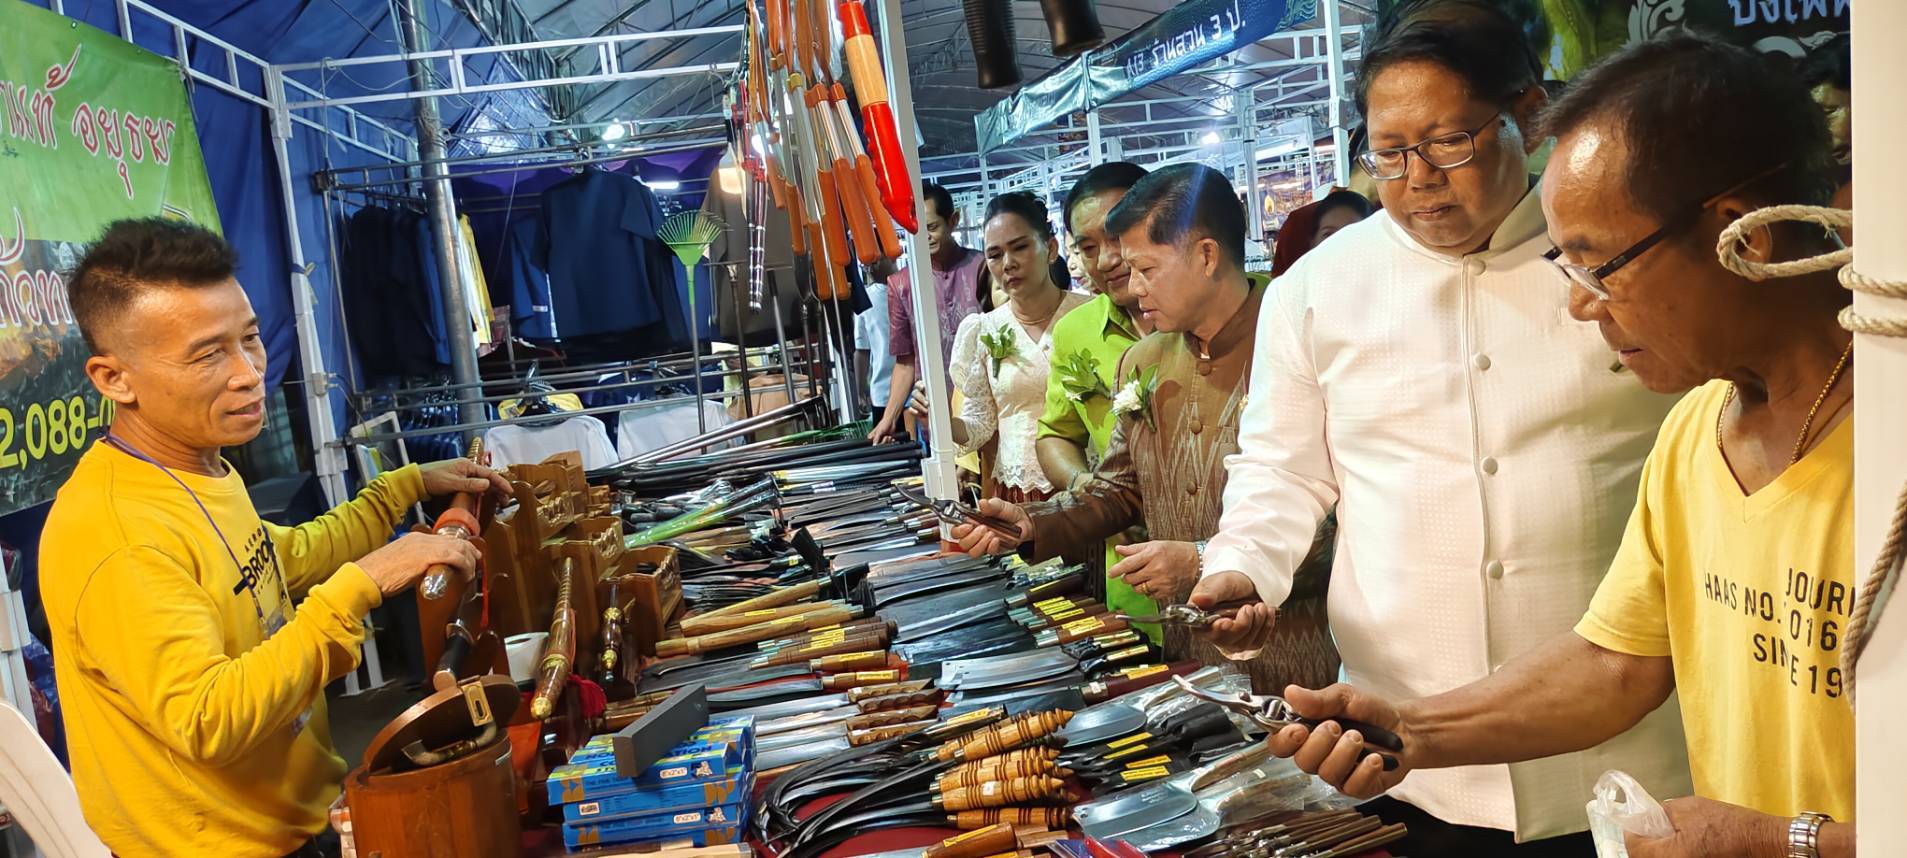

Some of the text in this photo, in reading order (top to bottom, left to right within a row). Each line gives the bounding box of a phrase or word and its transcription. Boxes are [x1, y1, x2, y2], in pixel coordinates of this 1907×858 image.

[241, 540, 274, 590] BROO
[1704, 572, 1737, 611] HAAS
[1744, 587, 1781, 624] NO.
